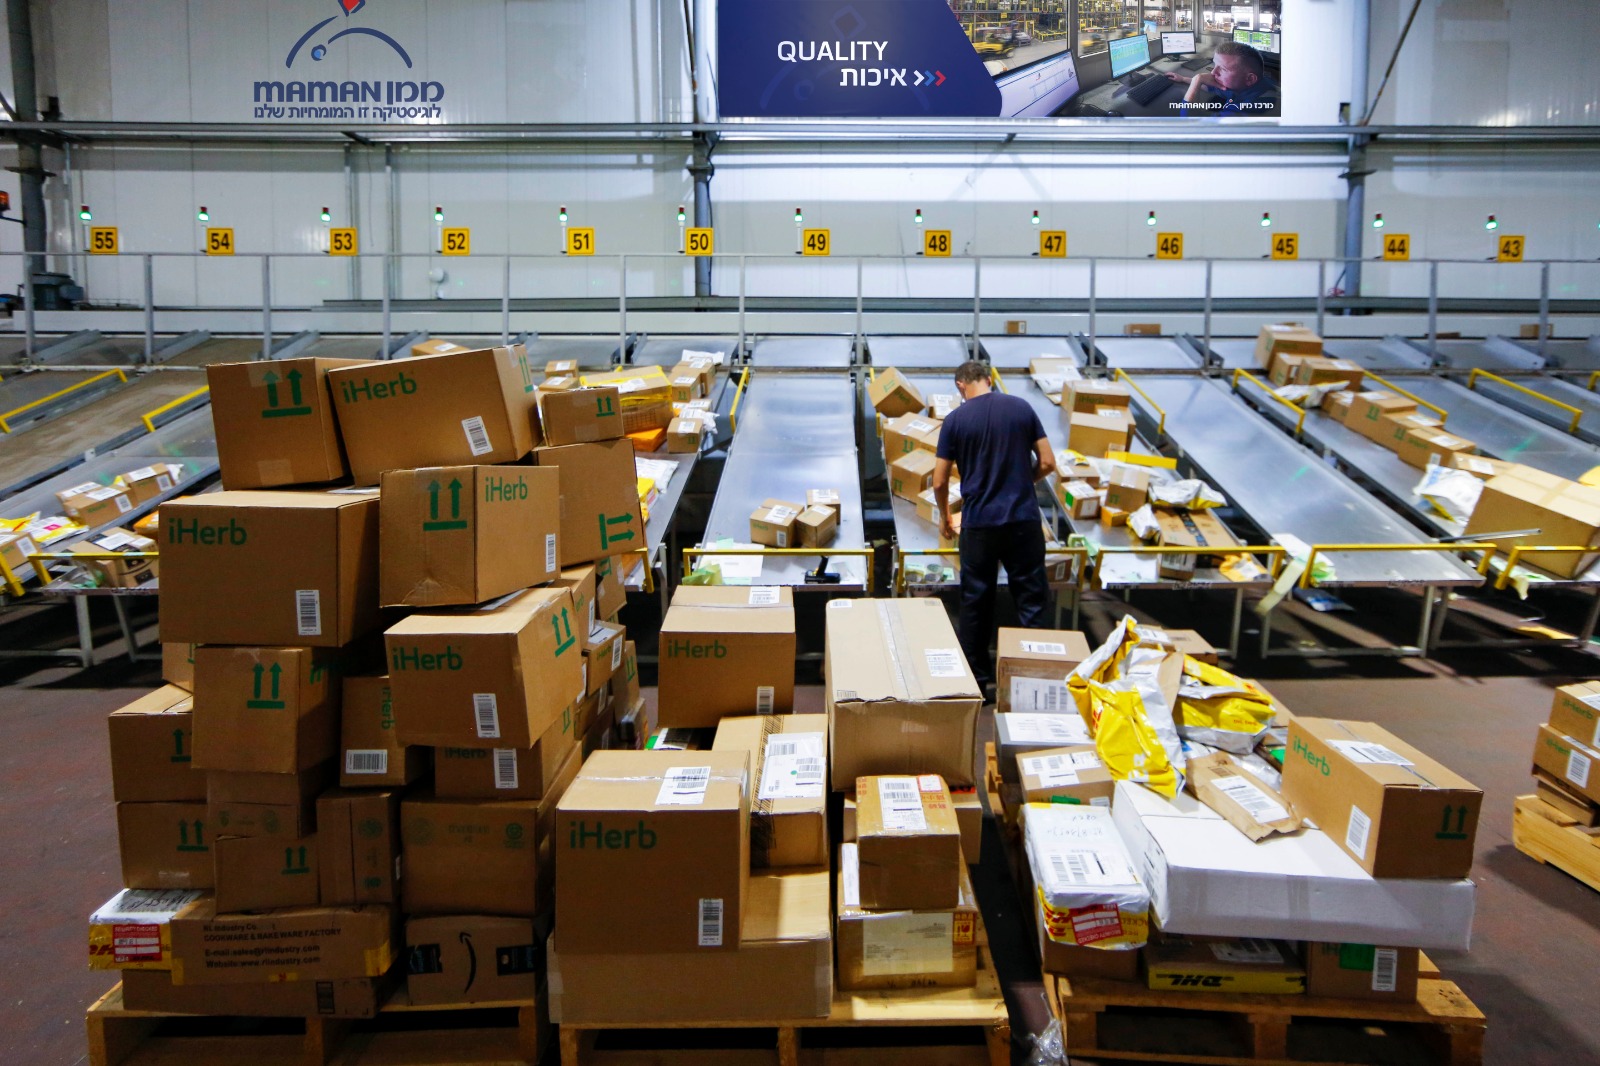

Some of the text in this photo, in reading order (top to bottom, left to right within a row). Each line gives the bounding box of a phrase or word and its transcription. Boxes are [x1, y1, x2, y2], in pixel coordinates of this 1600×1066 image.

[777, 40, 889, 62] QUALITY
[839, 68, 908, 87] איכות
[253, 81, 445, 105] MAMAN ממן
[254, 104, 442, 122] לוגיסטיקה זו המומחיות שלנו
[95, 231, 114, 249] 55
[211, 232, 230, 250] 54
[334, 232, 353, 251] 53
[447, 232, 466, 250] 52
[573, 232, 590, 250] 51
[690, 233, 709, 251] 50
[807, 233, 826, 251] 49
[928, 234, 947, 252] 48
[1044, 234, 1063, 252] 47
[1160, 237, 1179, 254] 46
[1275, 238, 1294, 256] 45
[1387, 239, 1406, 255] 44
[1502, 240, 1521, 257] 43
[341, 371, 417, 403] iHerb
[485, 477, 529, 502] iHerb
[169, 518, 247, 545] iHerb
[392, 645, 463, 672] iHerb
[668, 639, 727, 660] iHerb
[1293, 736, 1332, 777] iHerb
[570, 821, 657, 848] iHerb
[304, 927, 342, 937] FACTORY
[88, 944, 114, 956] DH
[1168, 974, 1224, 987] DHL
